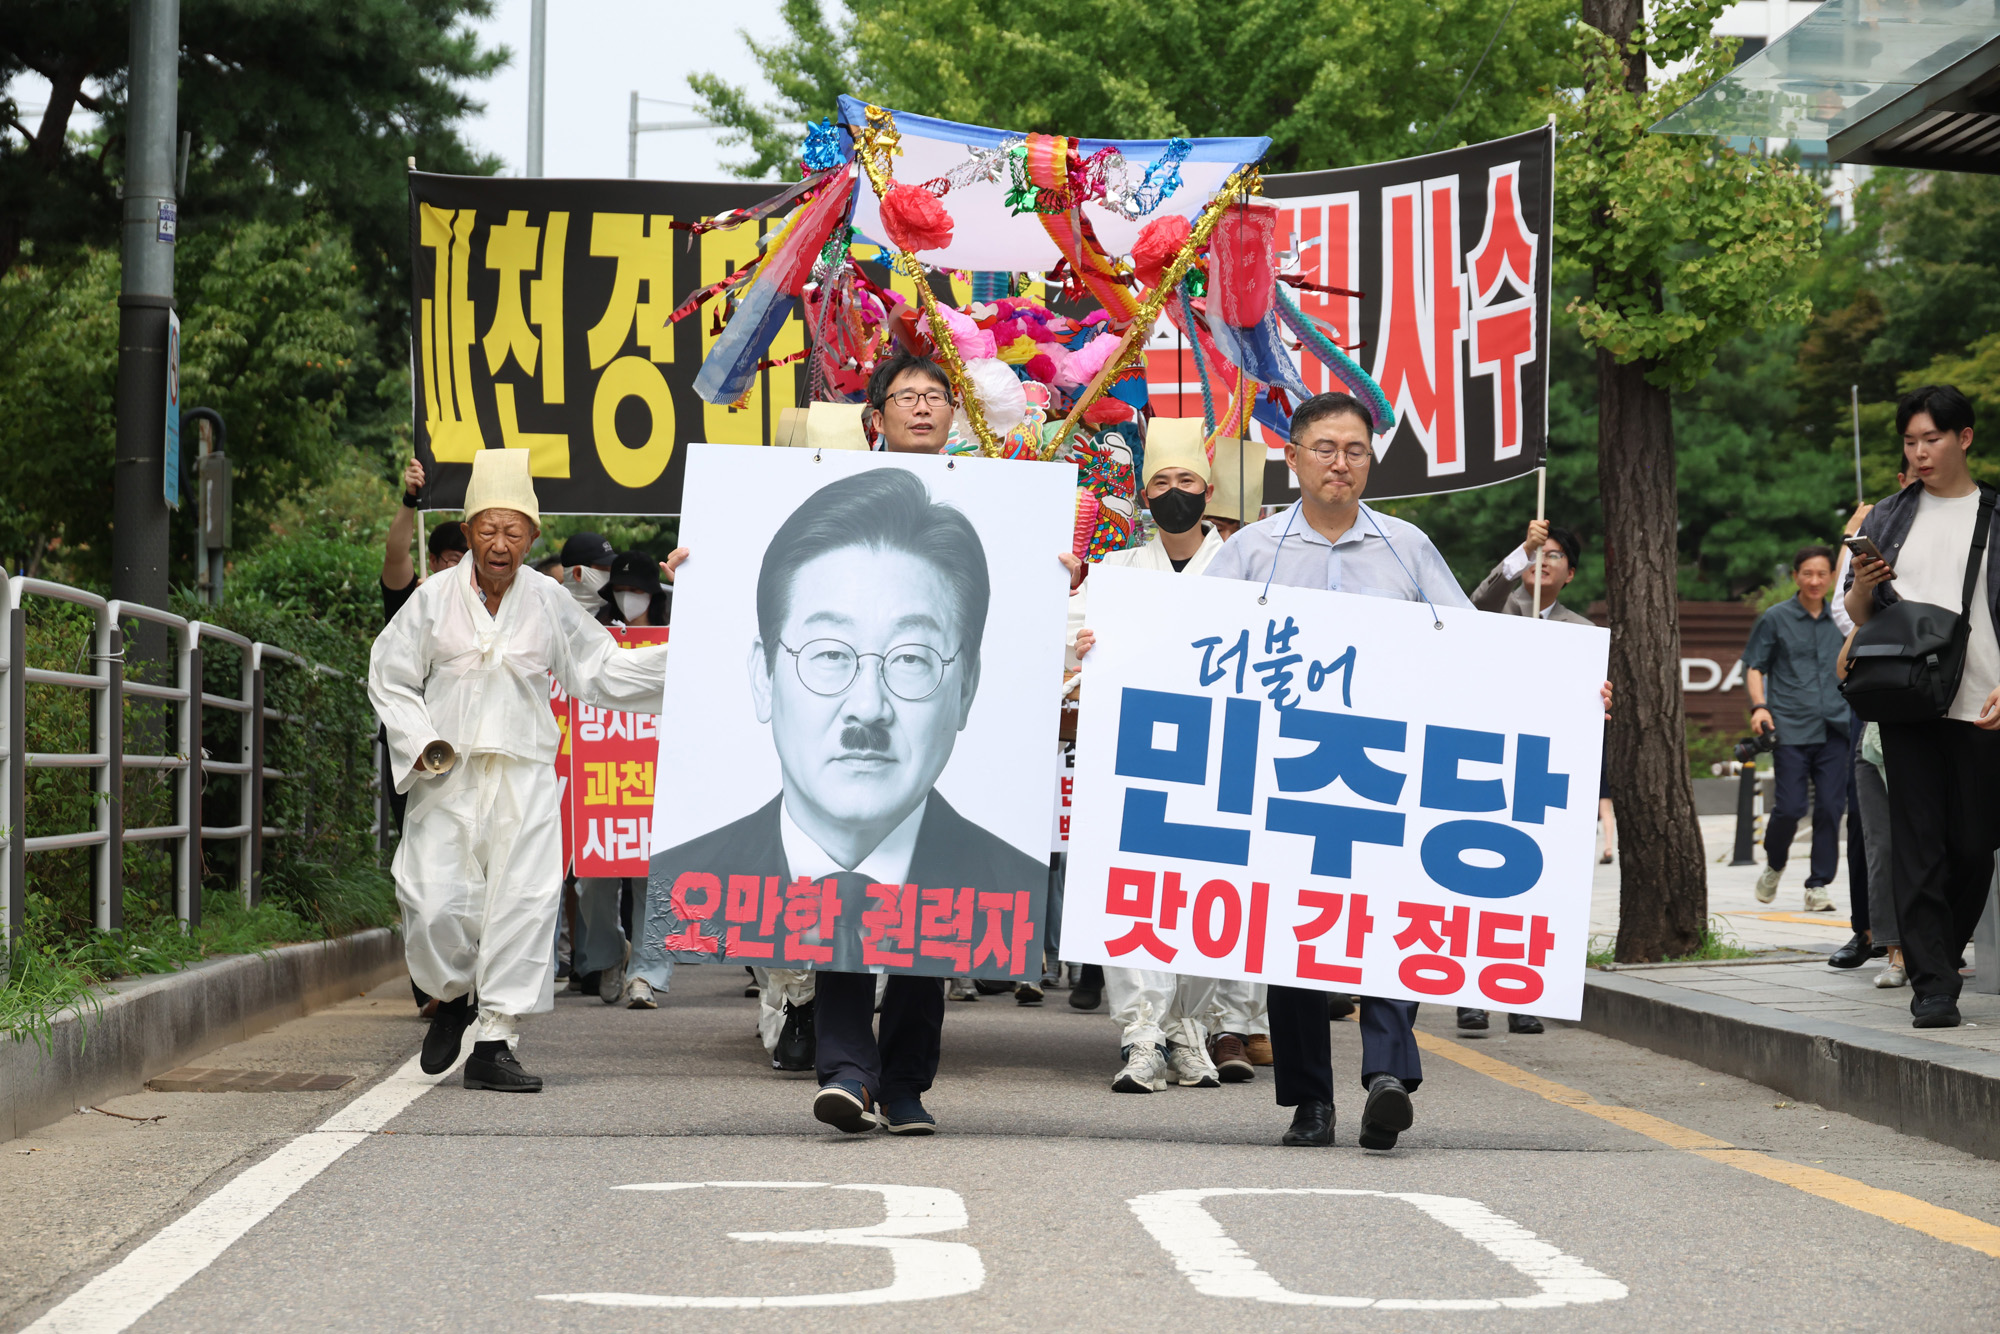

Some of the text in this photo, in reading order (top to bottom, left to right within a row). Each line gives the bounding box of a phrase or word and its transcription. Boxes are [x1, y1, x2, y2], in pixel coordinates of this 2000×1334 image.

[1191, 616, 1356, 712] 더불어
[1115, 687, 1570, 899] 민주당
[665, 871, 1034, 976] 오만한 권력자
[1104, 867, 1555, 1005] 맛이 간 정당
[533, 1182, 1629, 1310] 30
